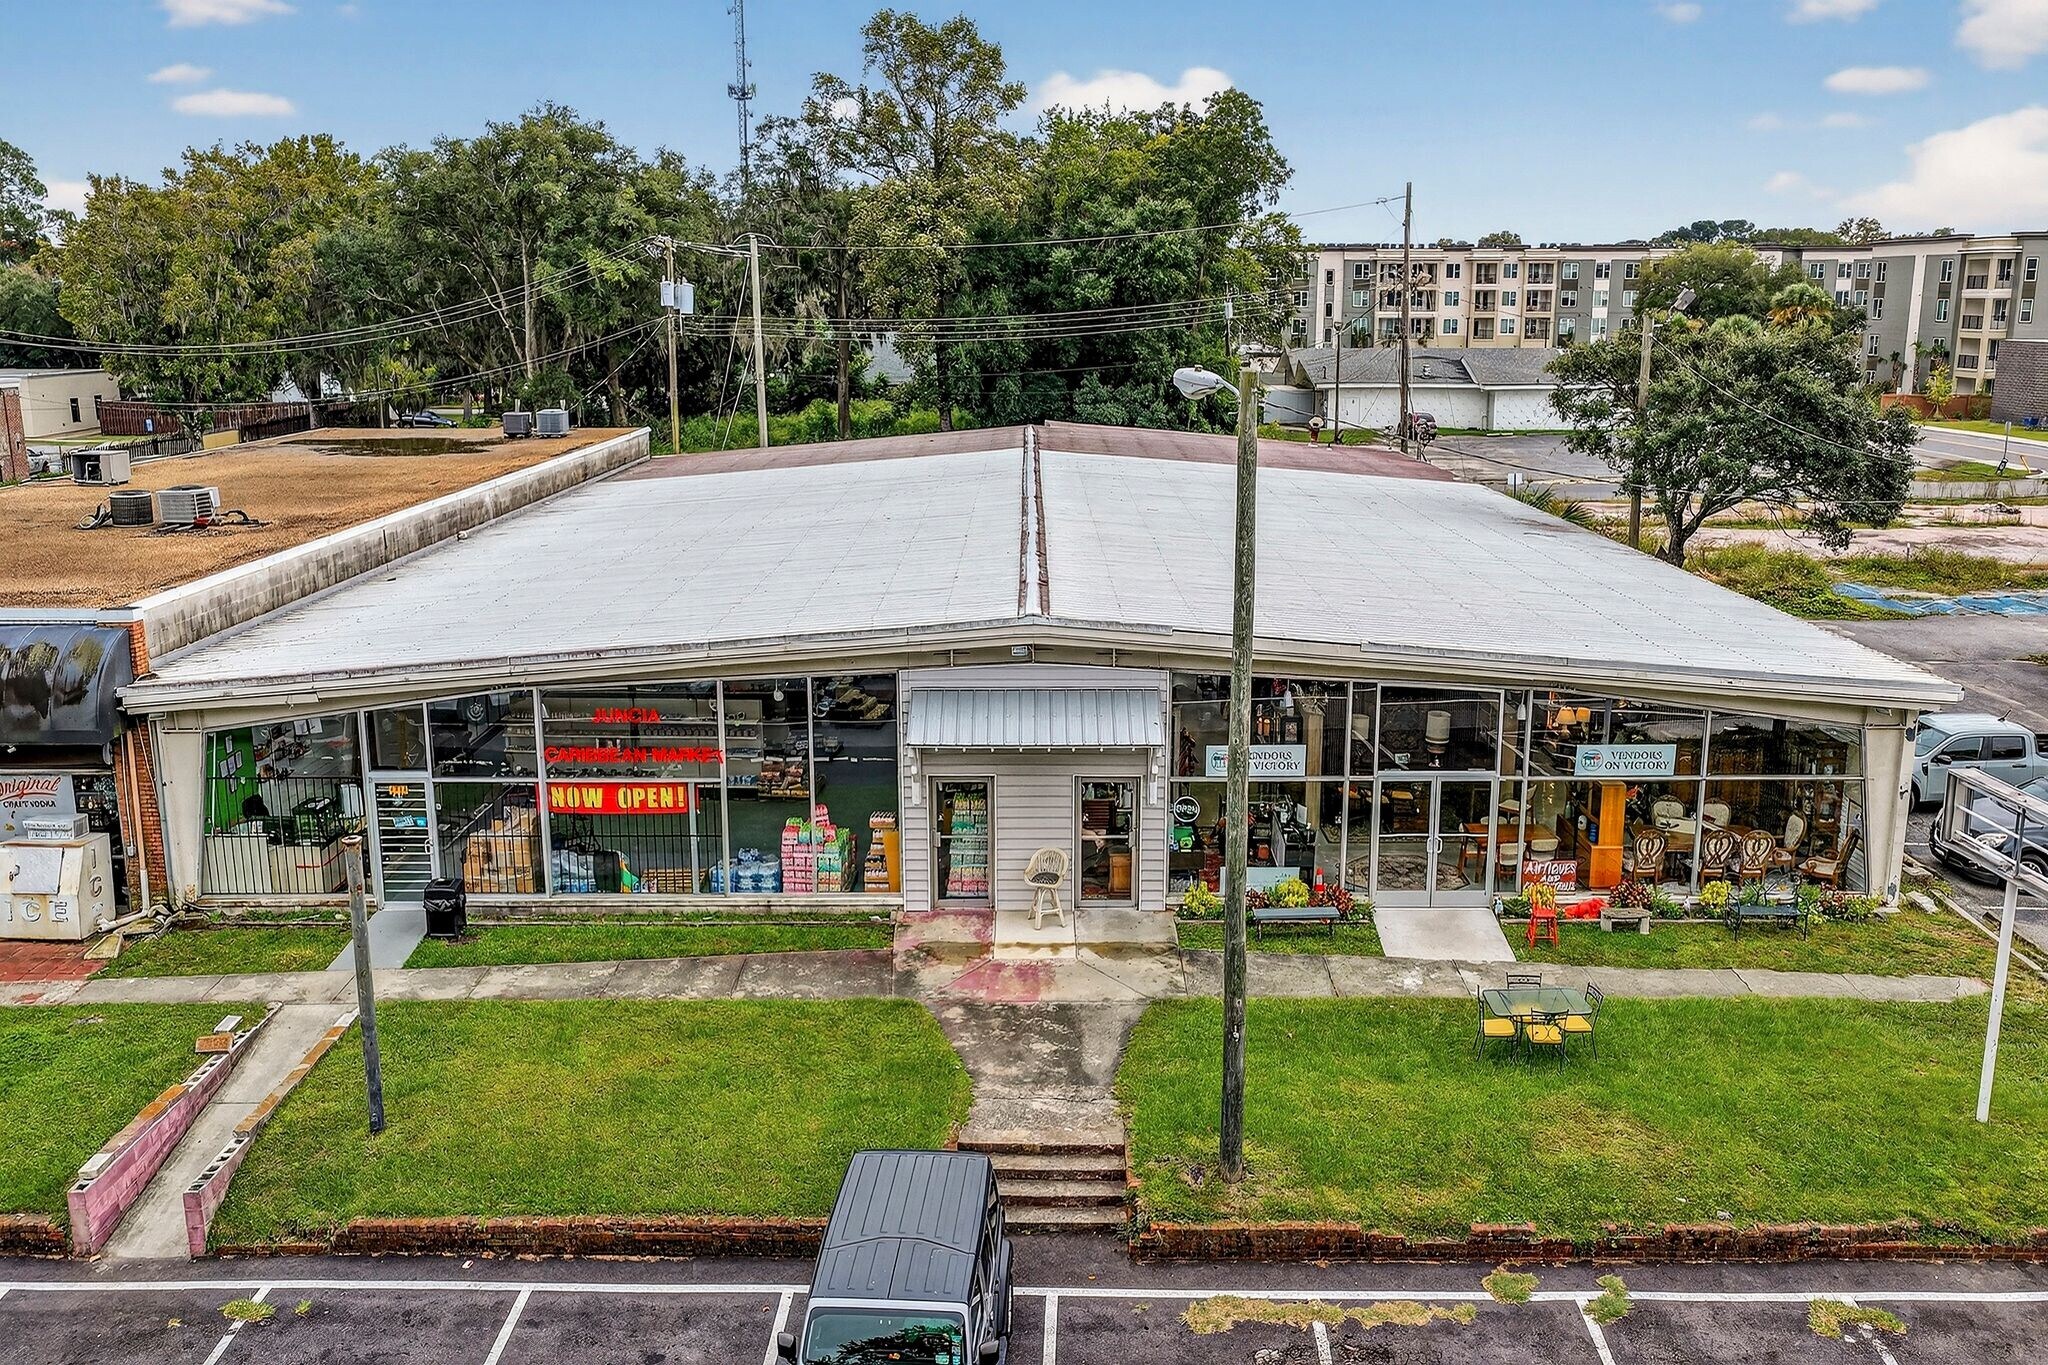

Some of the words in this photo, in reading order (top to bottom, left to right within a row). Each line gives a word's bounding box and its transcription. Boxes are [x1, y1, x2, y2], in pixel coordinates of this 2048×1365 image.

[544, 746, 647, 763] CARIBBEAN
[651, 746, 723, 763] MARKET
[1248, 751, 1293, 762] ENDORS
[1611, 751, 1663, 761] VENDORS
[1253, 761, 1301, 771] VICTORY
[1604, 760, 1620, 770] ON
[1622, 761, 1670, 770] VICTORY
[550, 786, 604, 809] NOW
[617, 785, 686, 809] OPEN!
[4, 900, 69, 922] ICE
